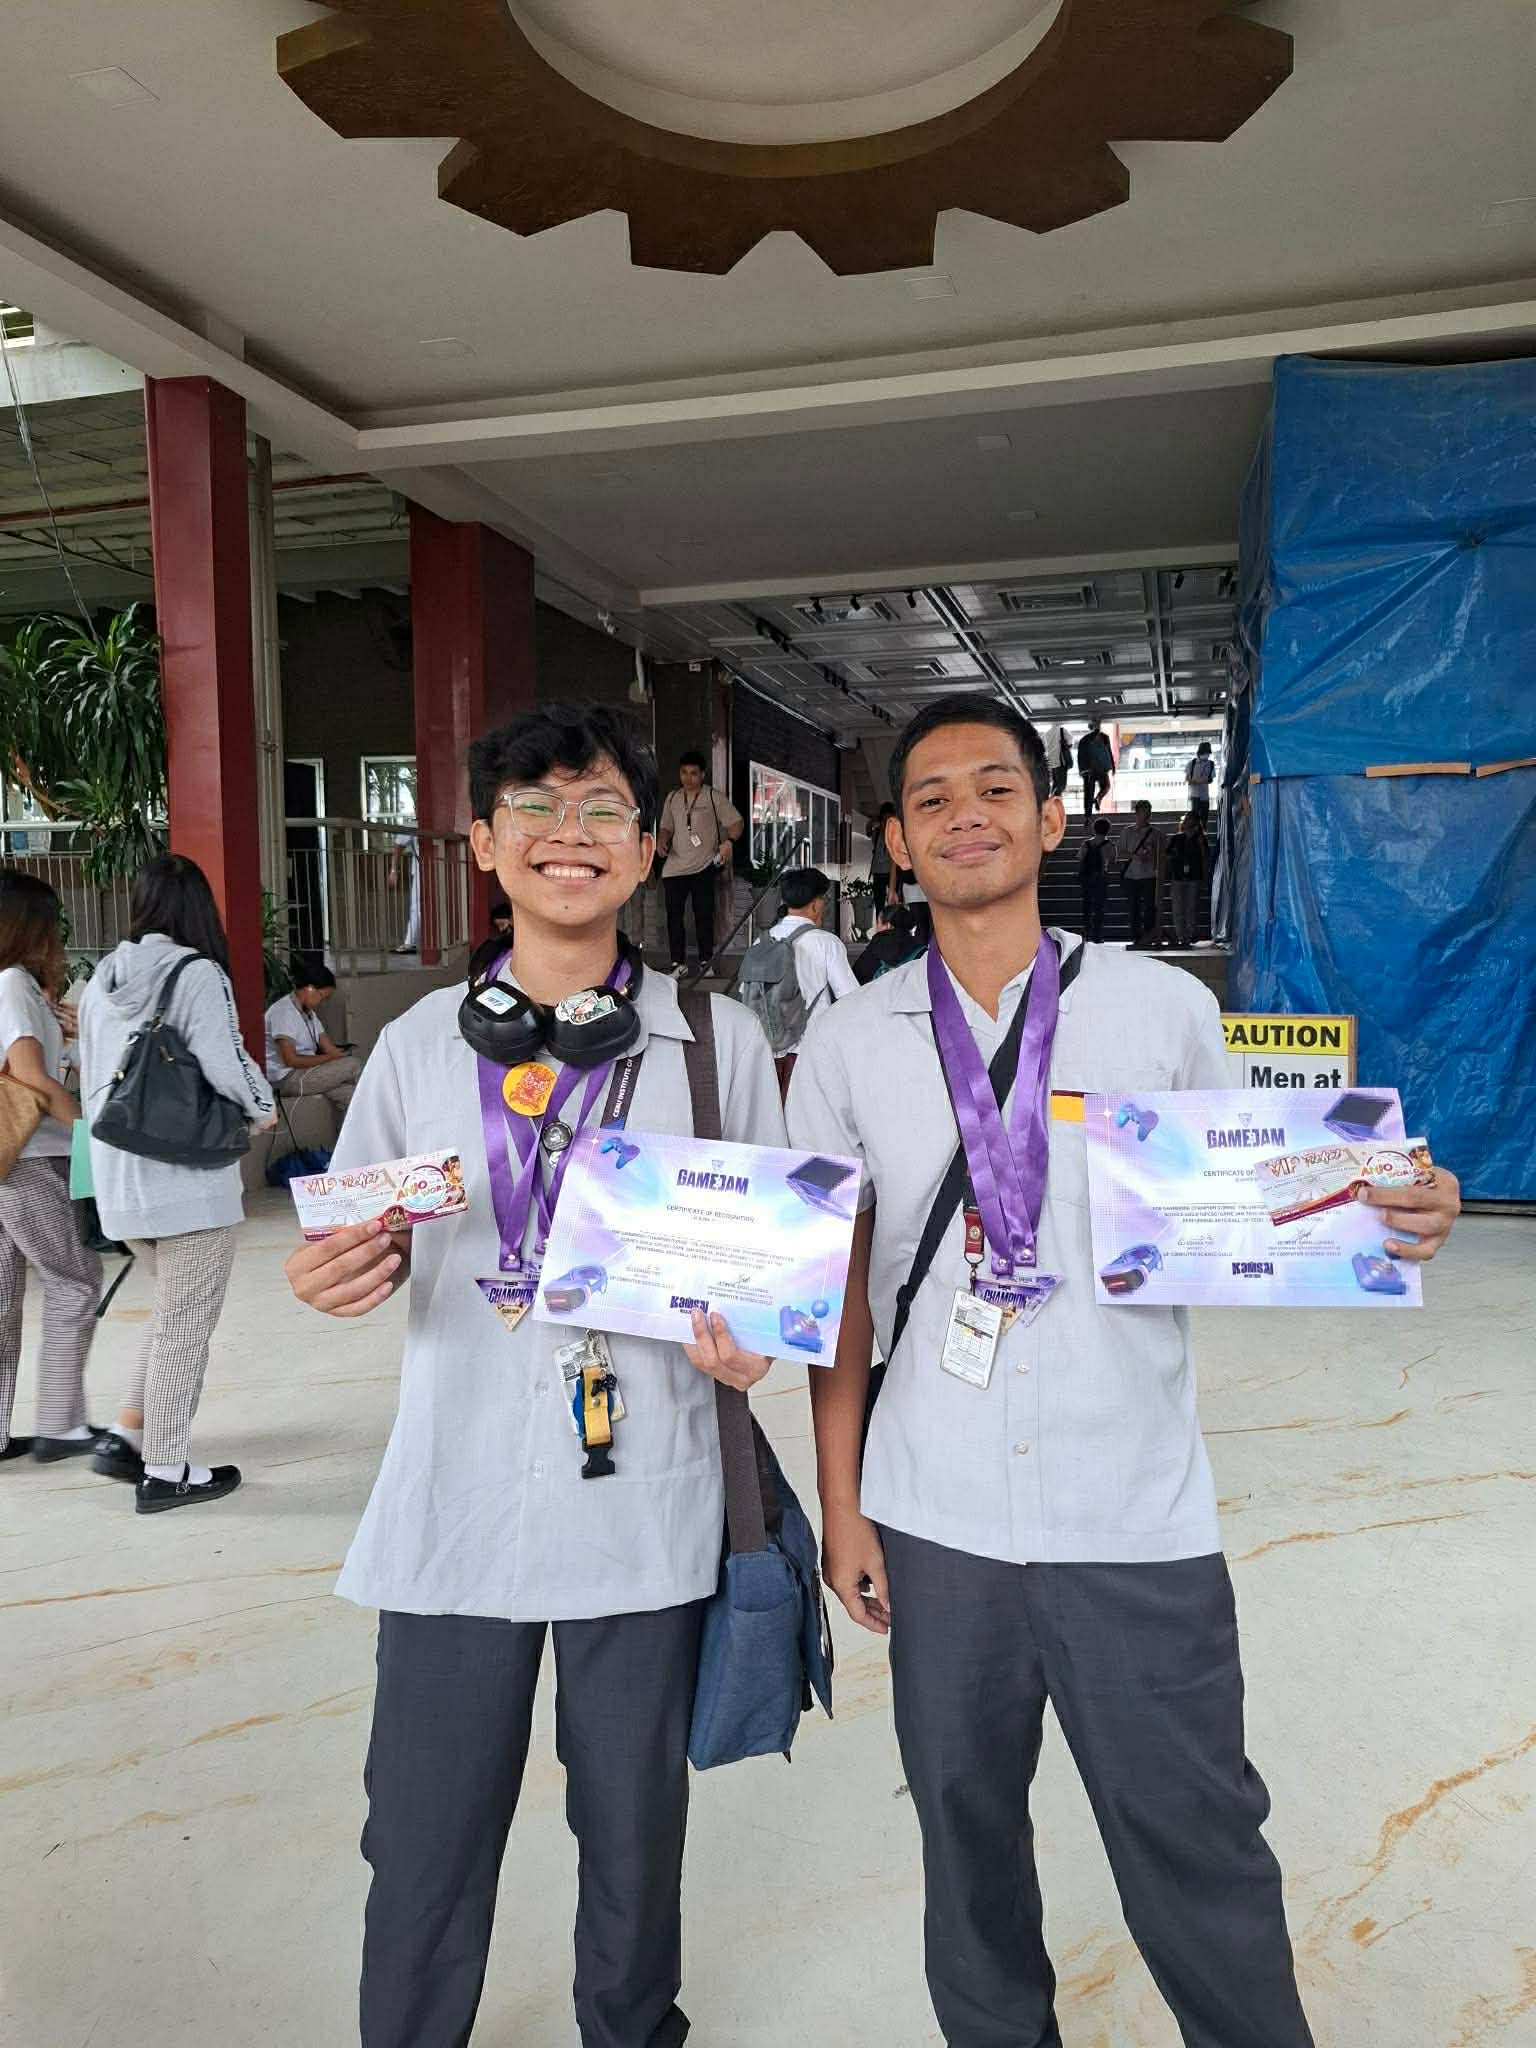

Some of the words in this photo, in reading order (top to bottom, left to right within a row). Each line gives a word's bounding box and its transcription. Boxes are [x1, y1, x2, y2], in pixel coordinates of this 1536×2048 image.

[618, 1068, 632, 1100] INSTITUTE
[1250, 1066, 1305, 1088] Men
[1314, 1069, 1342, 1088] at
[1203, 1169, 1245, 1177] CERTIFICATE
[1269, 1157, 1300, 1177] VIP
[303, 1178, 337, 1198] VIP
[666, 1204, 705, 1215] CERTIFICATE
[488, 1288, 536, 1304] CHAMPION
